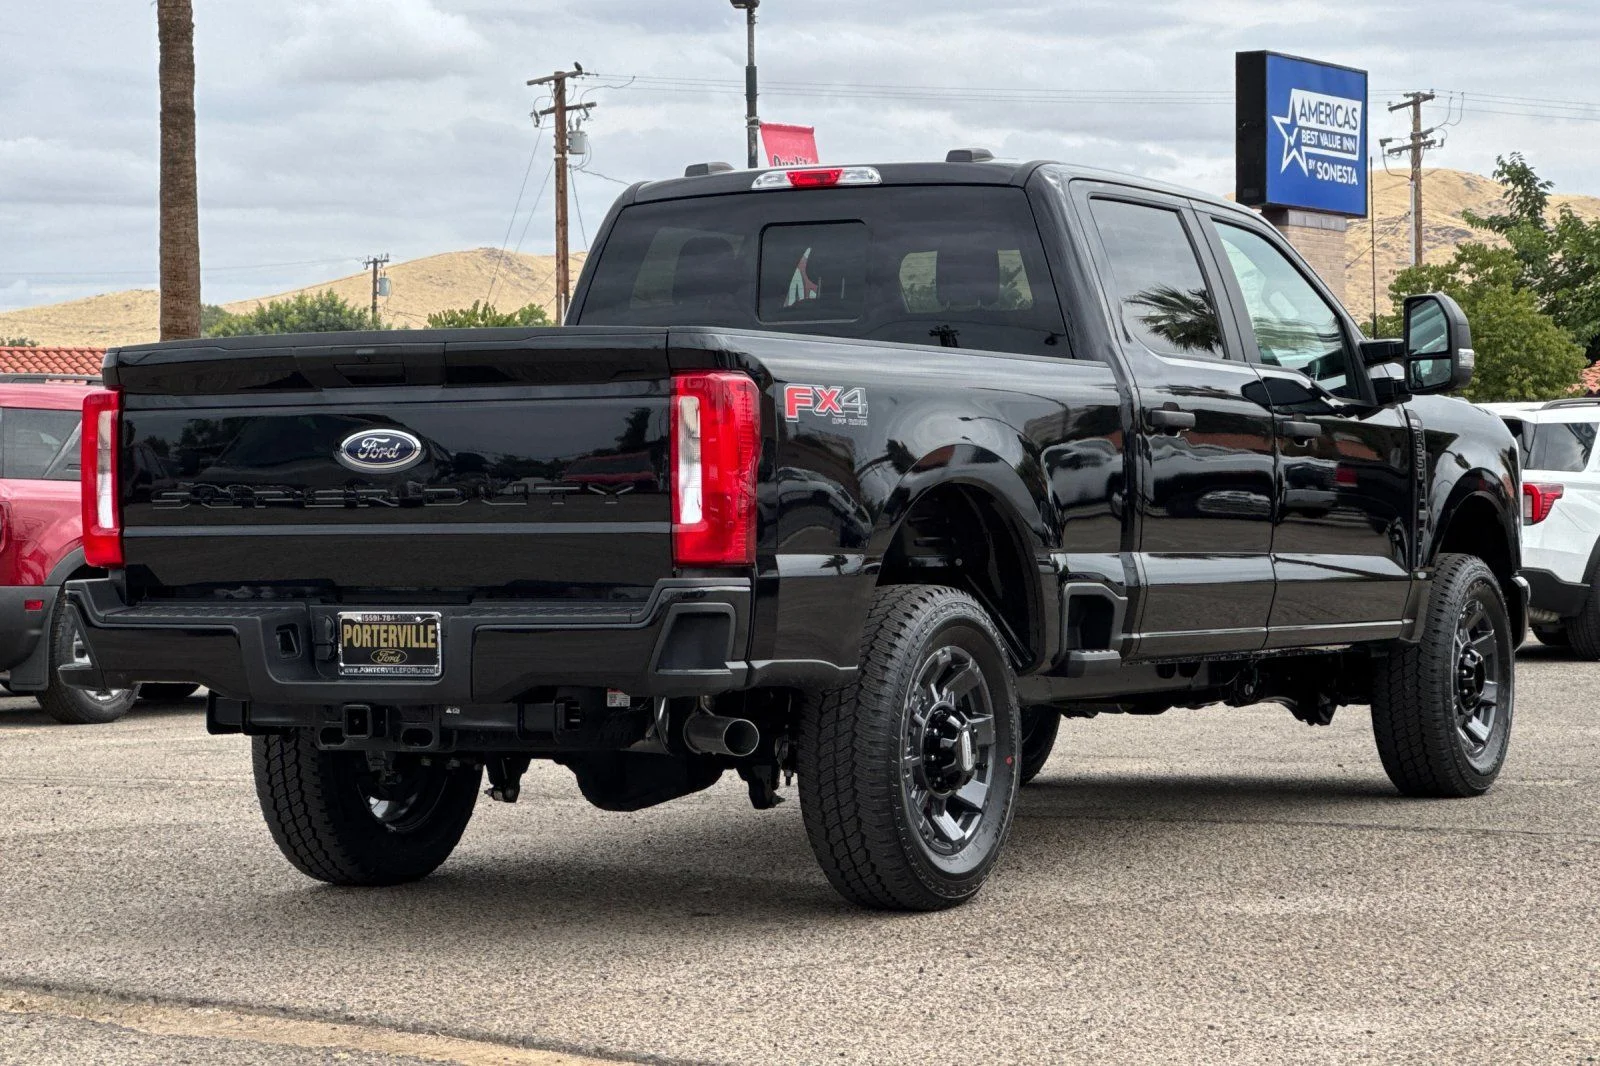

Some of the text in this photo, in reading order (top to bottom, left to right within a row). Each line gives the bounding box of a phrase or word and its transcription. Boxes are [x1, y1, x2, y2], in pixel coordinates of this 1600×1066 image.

[1299, 98, 1358, 130] AMERICAS
[1301, 129, 1356, 152] BEST VALUE INN
[1308, 159, 1358, 185] BY SONESTA
[784, 383, 868, 422] FX4
[357, 437, 400, 459] Ford
[343, 624, 436, 648] PORTERVILLE
[377, 650, 401, 663] Ford
